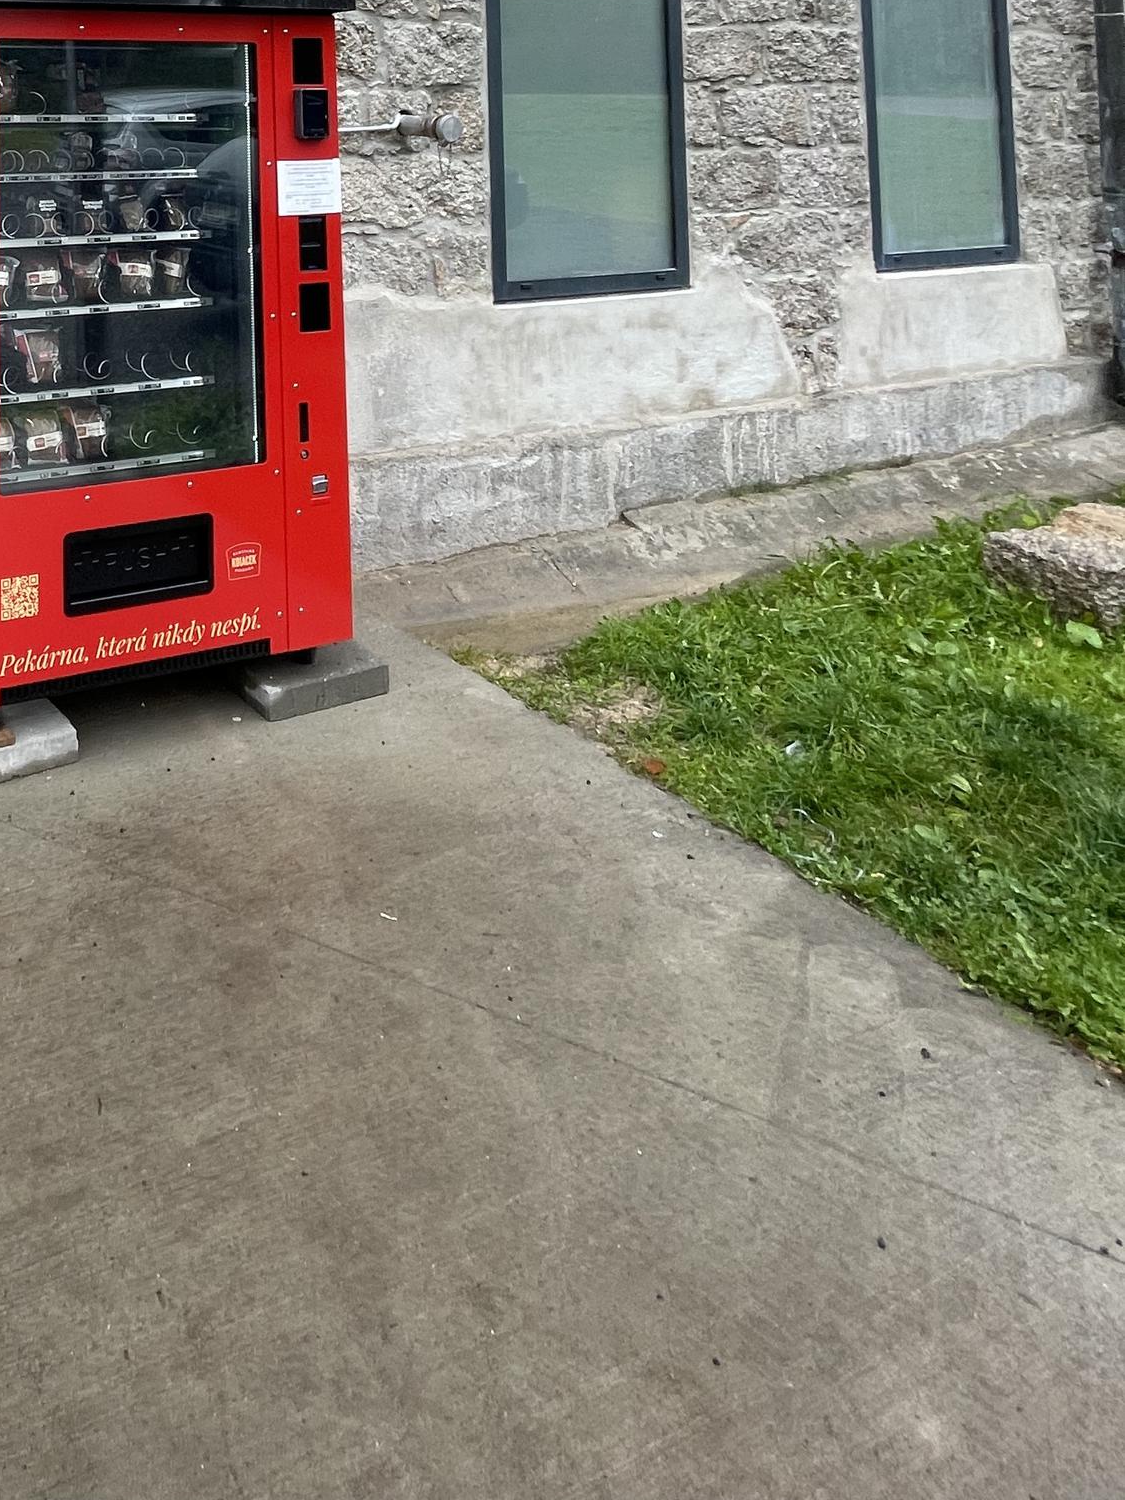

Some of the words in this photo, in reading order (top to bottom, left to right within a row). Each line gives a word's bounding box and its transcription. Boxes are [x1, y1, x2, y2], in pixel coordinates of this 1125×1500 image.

[0, 644, 90, 677] Pekárna,
[96, 627, 147, 659] která
[152, 619, 206, 650] nikdy
[210, 607, 262, 638] nespí.
